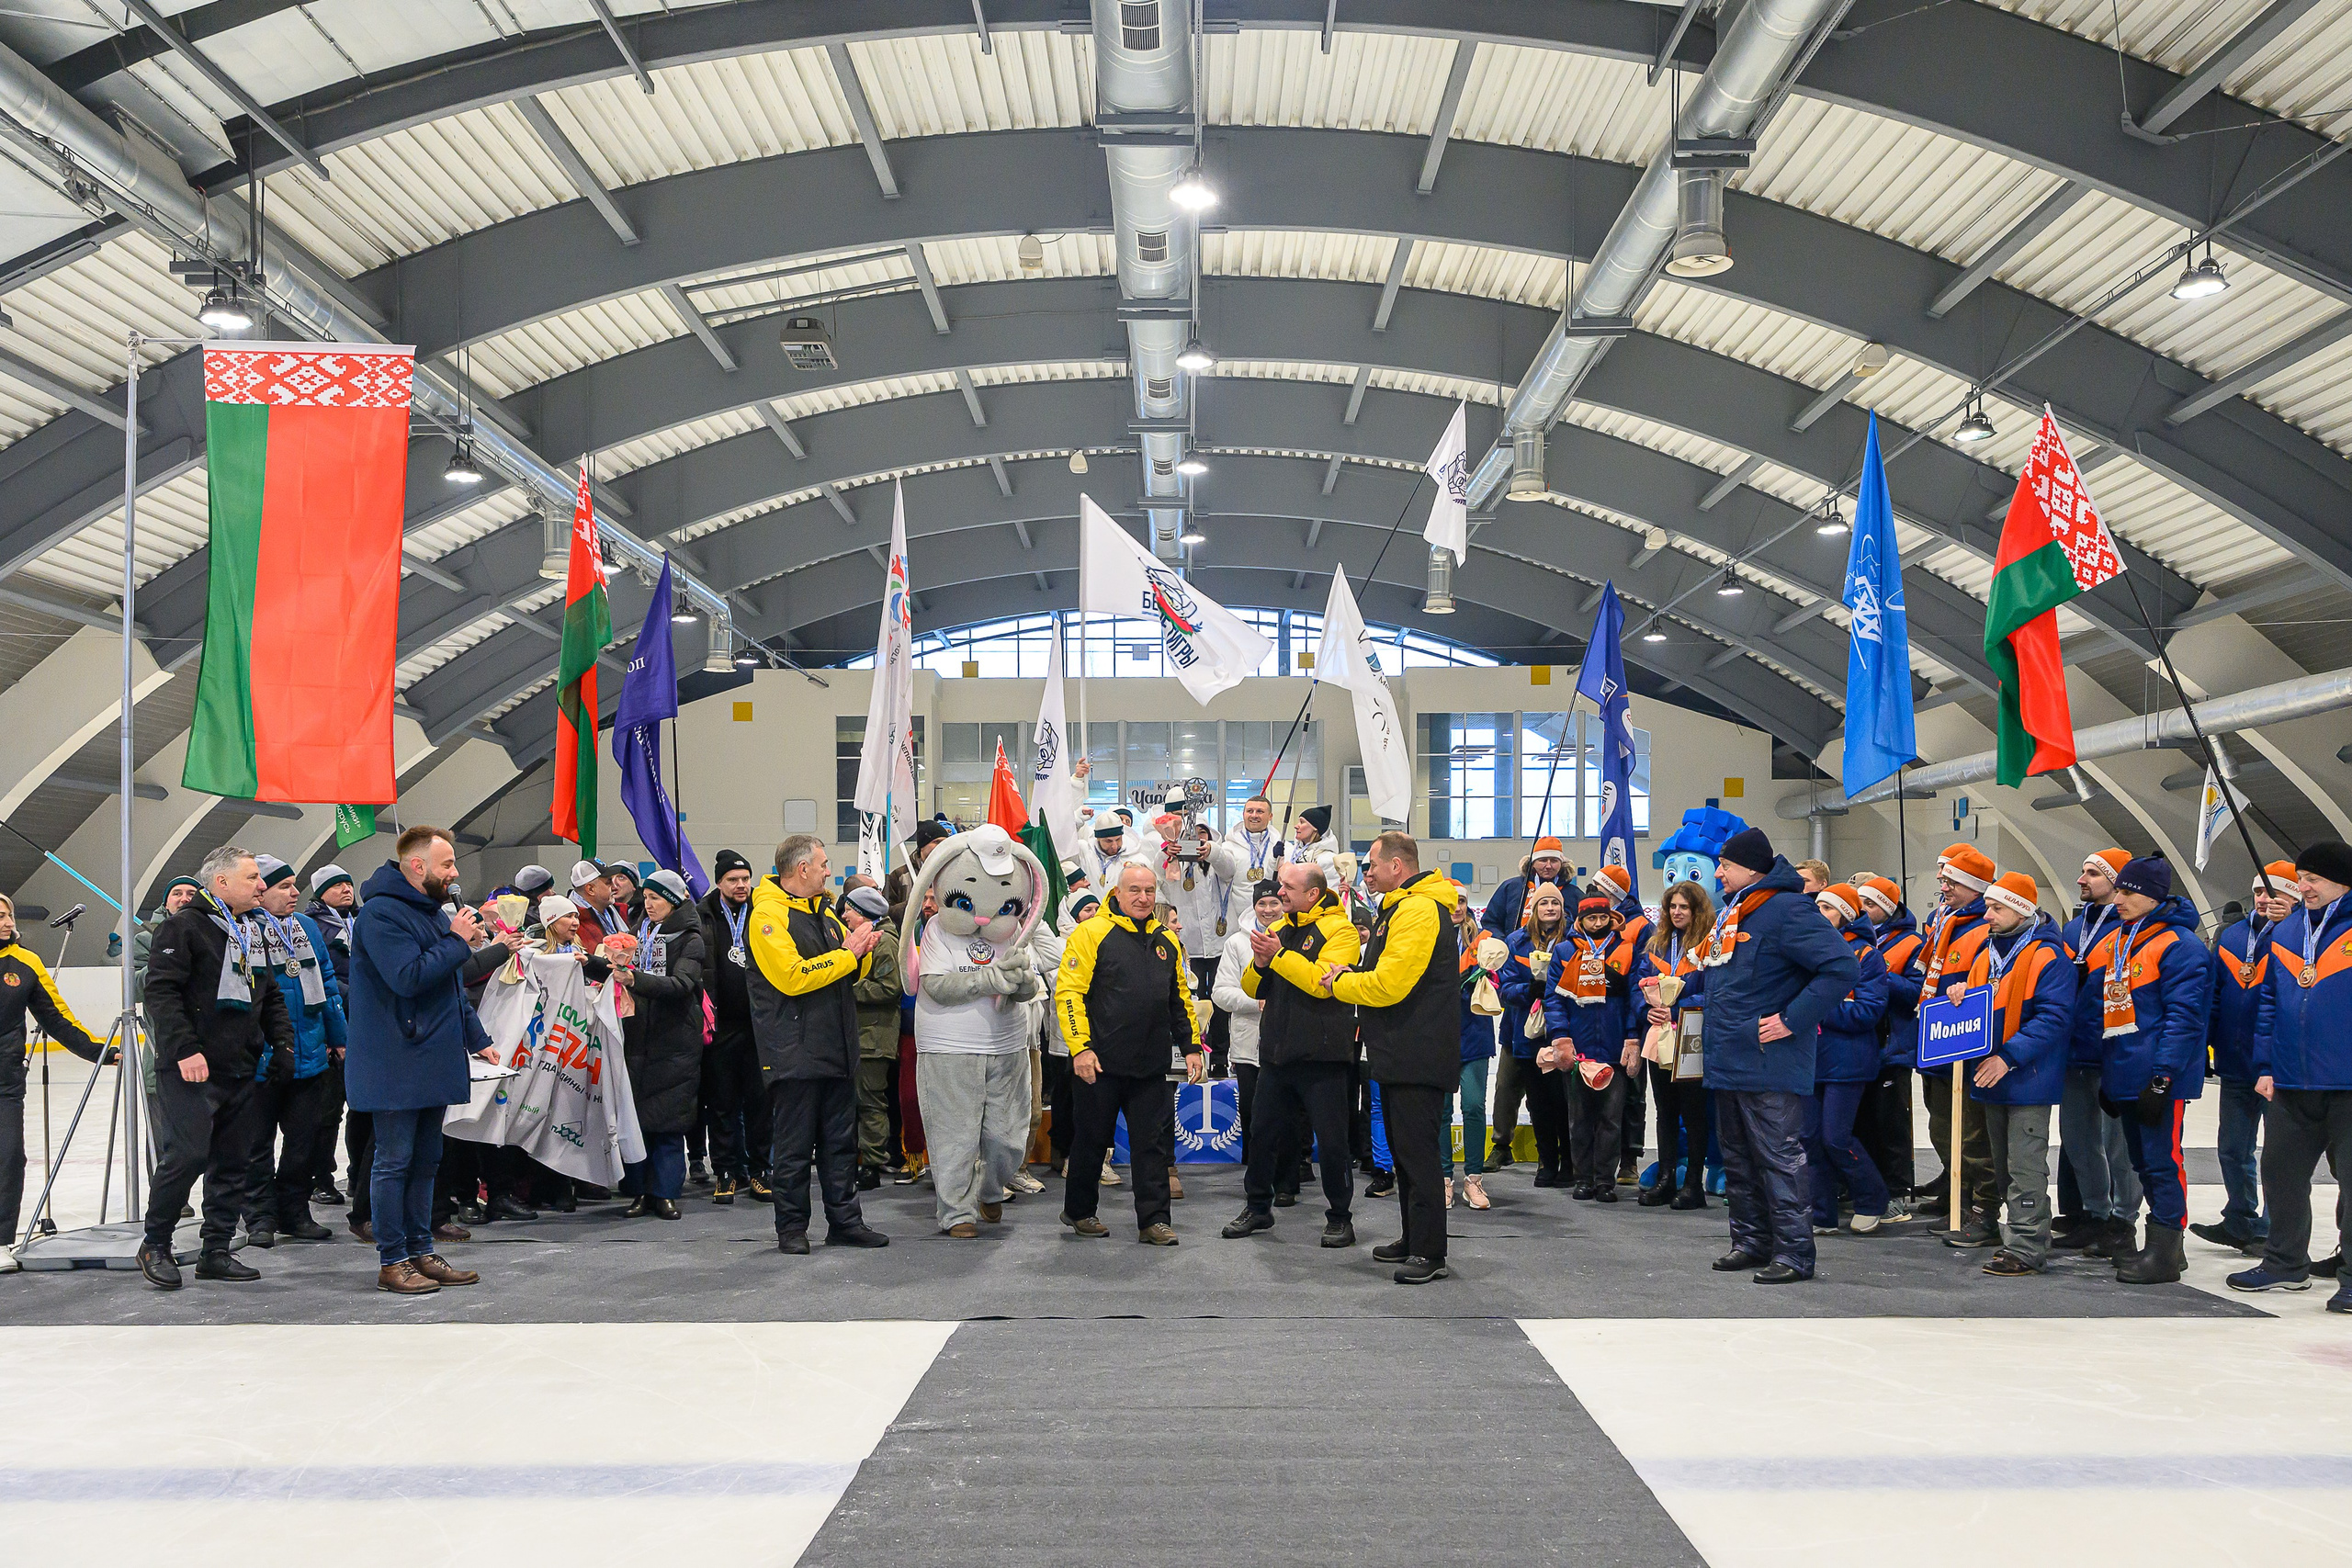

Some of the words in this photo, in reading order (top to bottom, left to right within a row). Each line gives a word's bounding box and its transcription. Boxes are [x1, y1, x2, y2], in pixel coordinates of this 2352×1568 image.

[2004, 895, 2031, 911] БЕЛАРУСЬ
[1066, 998, 1080, 1037] BELARUS
[1929, 1017, 1982, 1041] Молния
